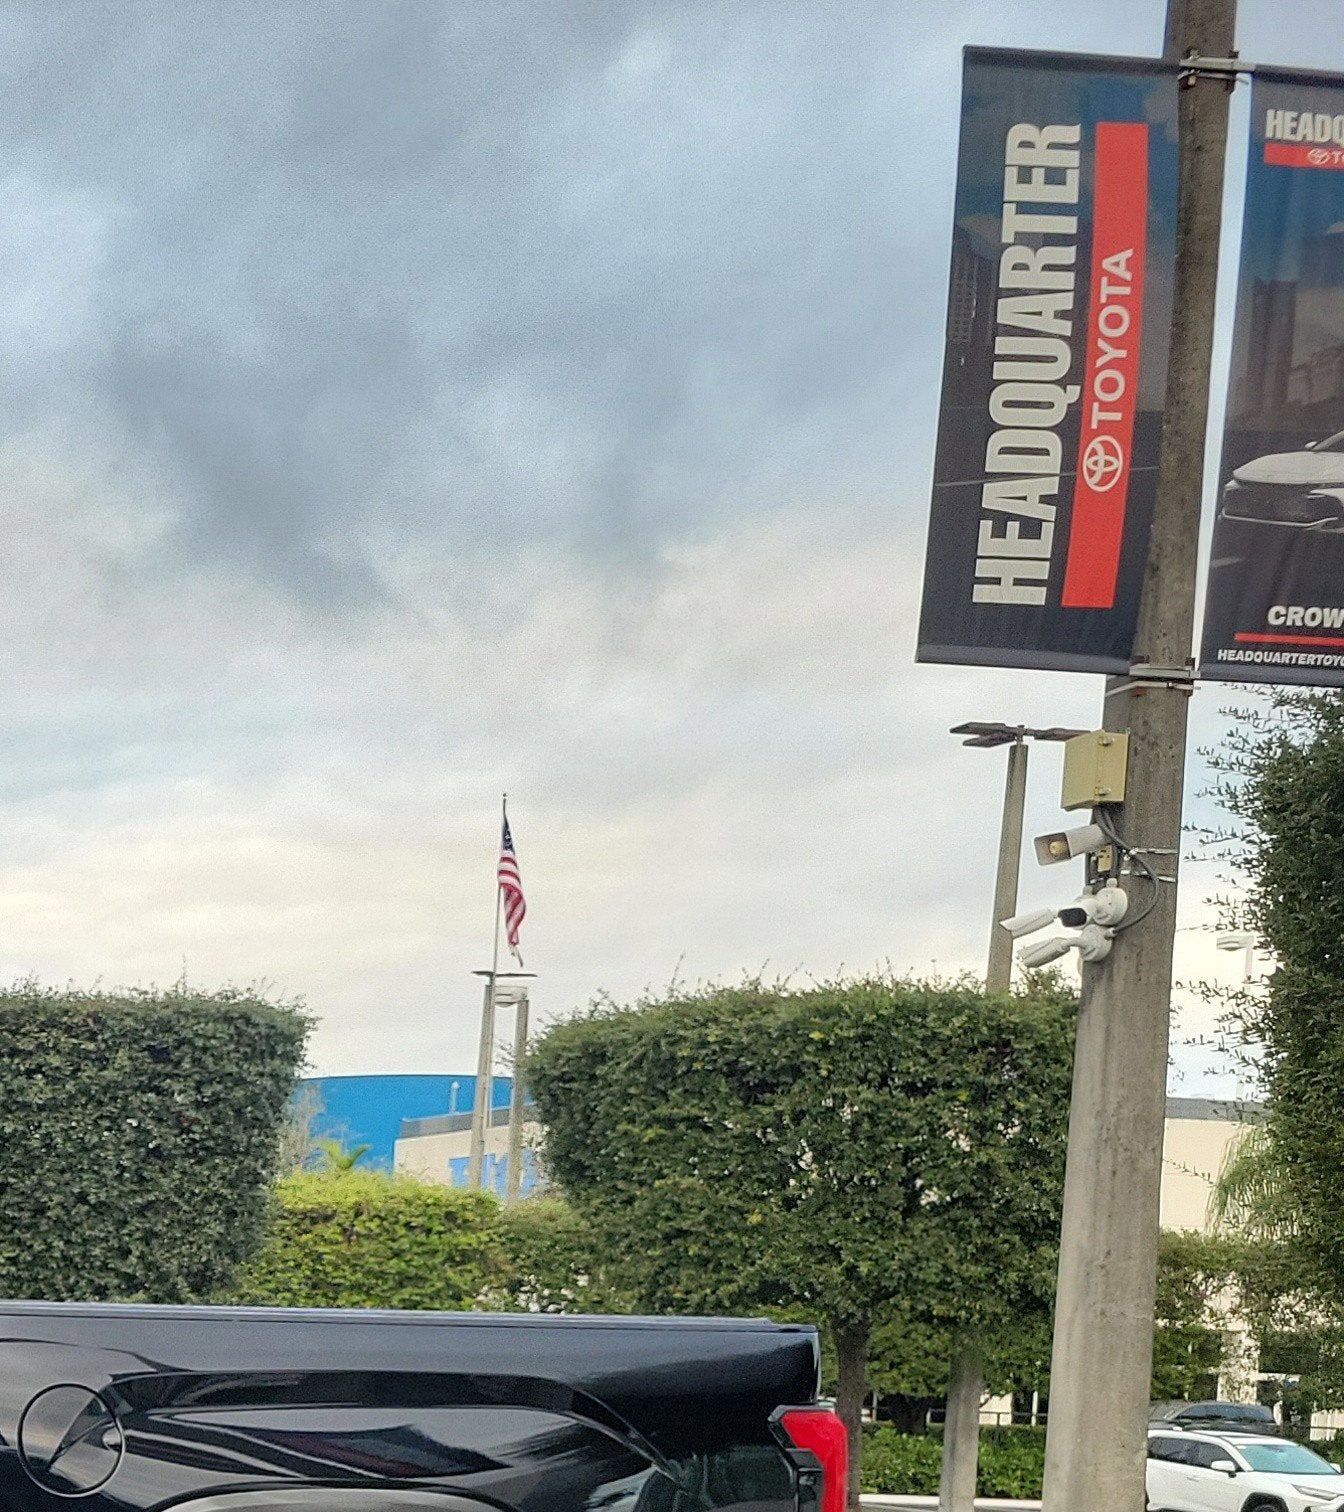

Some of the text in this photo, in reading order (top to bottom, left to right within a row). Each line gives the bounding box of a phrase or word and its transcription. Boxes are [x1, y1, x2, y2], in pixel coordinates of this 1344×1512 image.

[972, 122, 1081, 606] HEADQUARTER
[1091, 248, 1134, 430] TOYOTA
[1267, 605, 1344, 629] CROW
